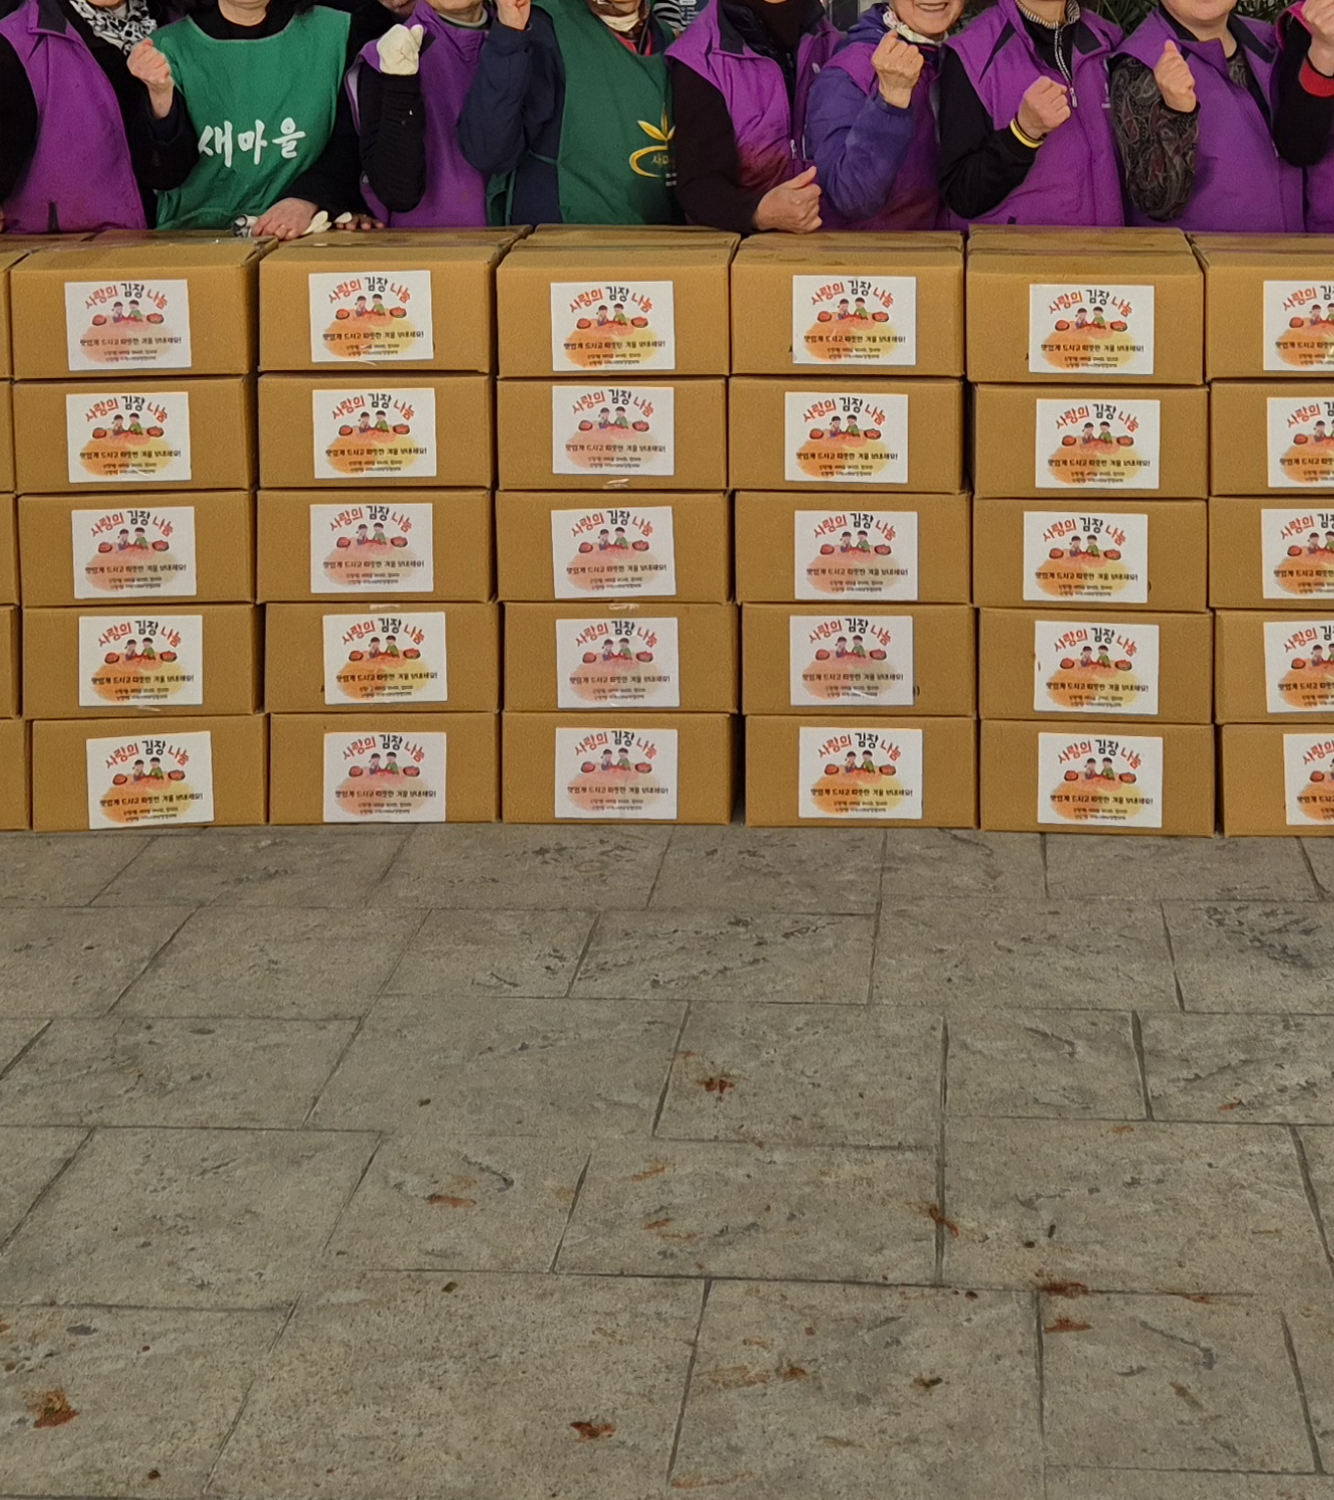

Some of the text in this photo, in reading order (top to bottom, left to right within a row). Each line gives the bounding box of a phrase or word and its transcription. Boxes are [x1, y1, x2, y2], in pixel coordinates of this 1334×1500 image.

[197, 116, 307, 168] 새마을
[328, 276, 411, 304] 사랑의 김장 나눔
[811, 280, 894, 309] 사랑의 김장 나눔
[1283, 287, 1318, 311] 사랑의
[85, 395, 168, 424] 사랑의 김장 나눔
[572, 389, 654, 418] 사랑의 김장 나눔
[803, 396, 886, 426] 사랑의 김장 나눔
[1055, 403, 1139, 433] 사랑의 김장 나눔
[330, 505, 412, 534] 사랑의 김장 나눔
[814, 512, 896, 542] 사랑의 김장 나눔
[1280, 515, 1315, 540] 사랑의
[98, 619, 182, 648] 사랑의 김장 나눔
[576, 620, 658, 649] 사랑의 김장 나눔
[1054, 627, 1137, 657] 사랑의 김장 나눔
[343, 734, 425, 763] 사랑의 김장 나눔
